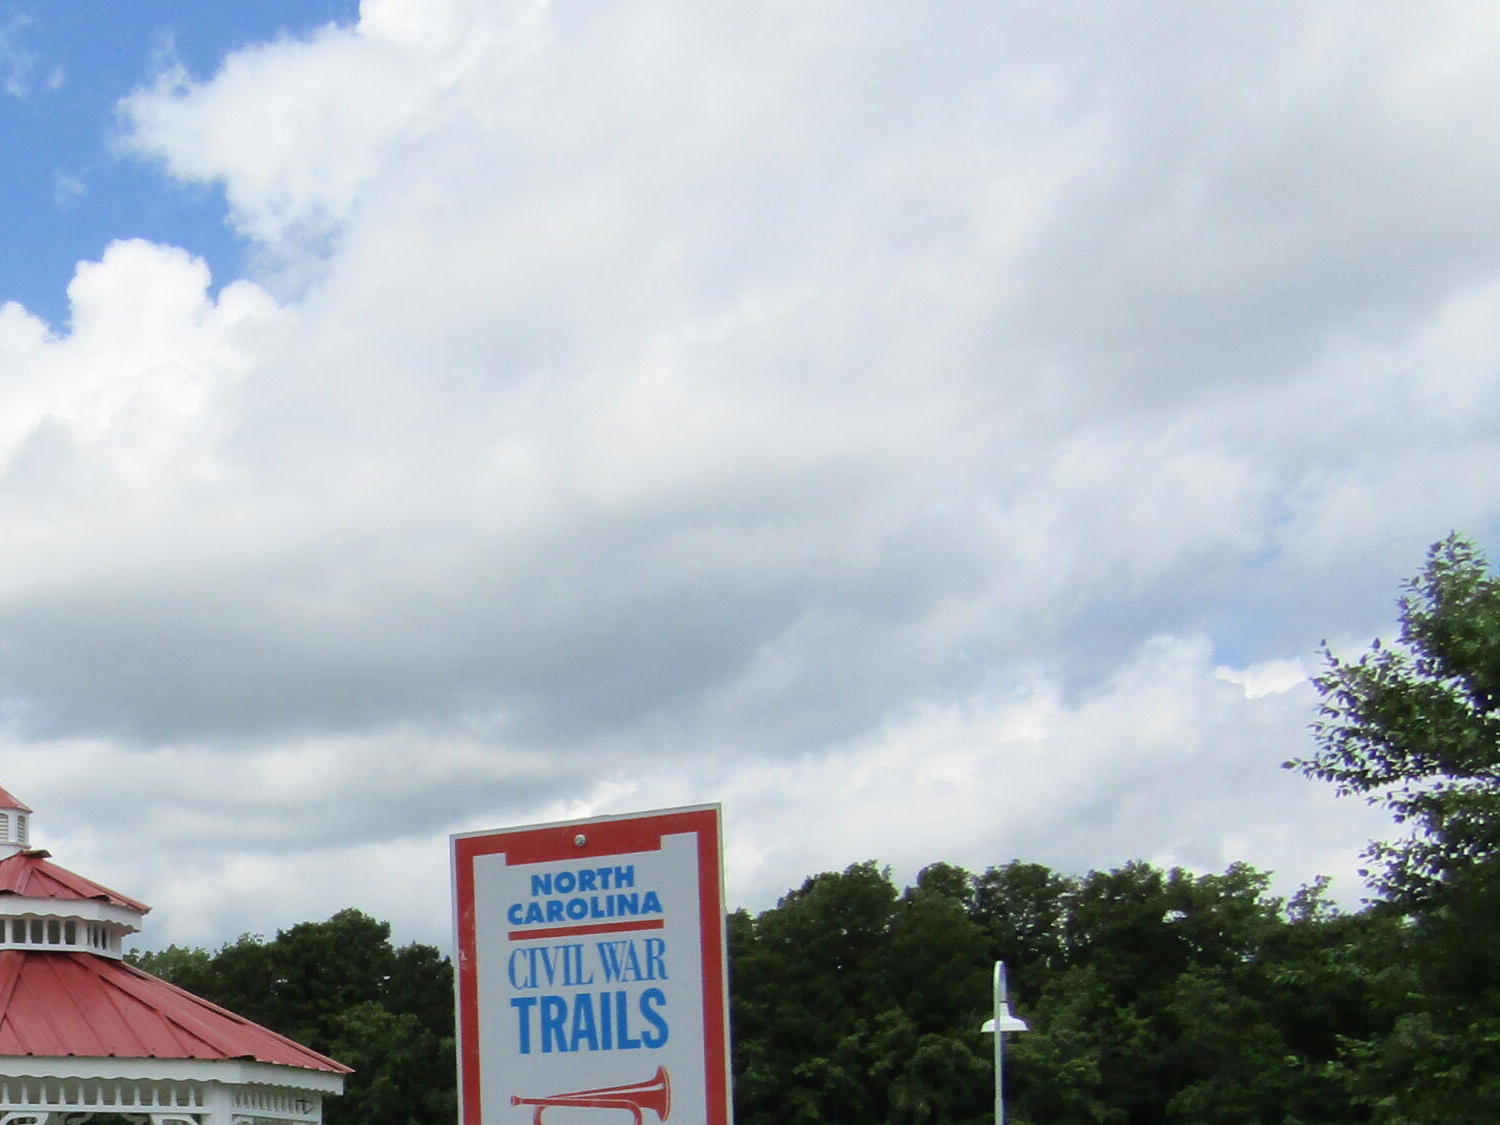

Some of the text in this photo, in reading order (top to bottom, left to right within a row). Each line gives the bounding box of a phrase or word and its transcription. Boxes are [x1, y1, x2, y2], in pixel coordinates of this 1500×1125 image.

[530, 865, 635, 897] NORTH
[507, 890, 663, 925] CAROLINA
[508, 938, 668, 990] CIVIL WAR
[510, 987, 670, 1054] TRAILS
